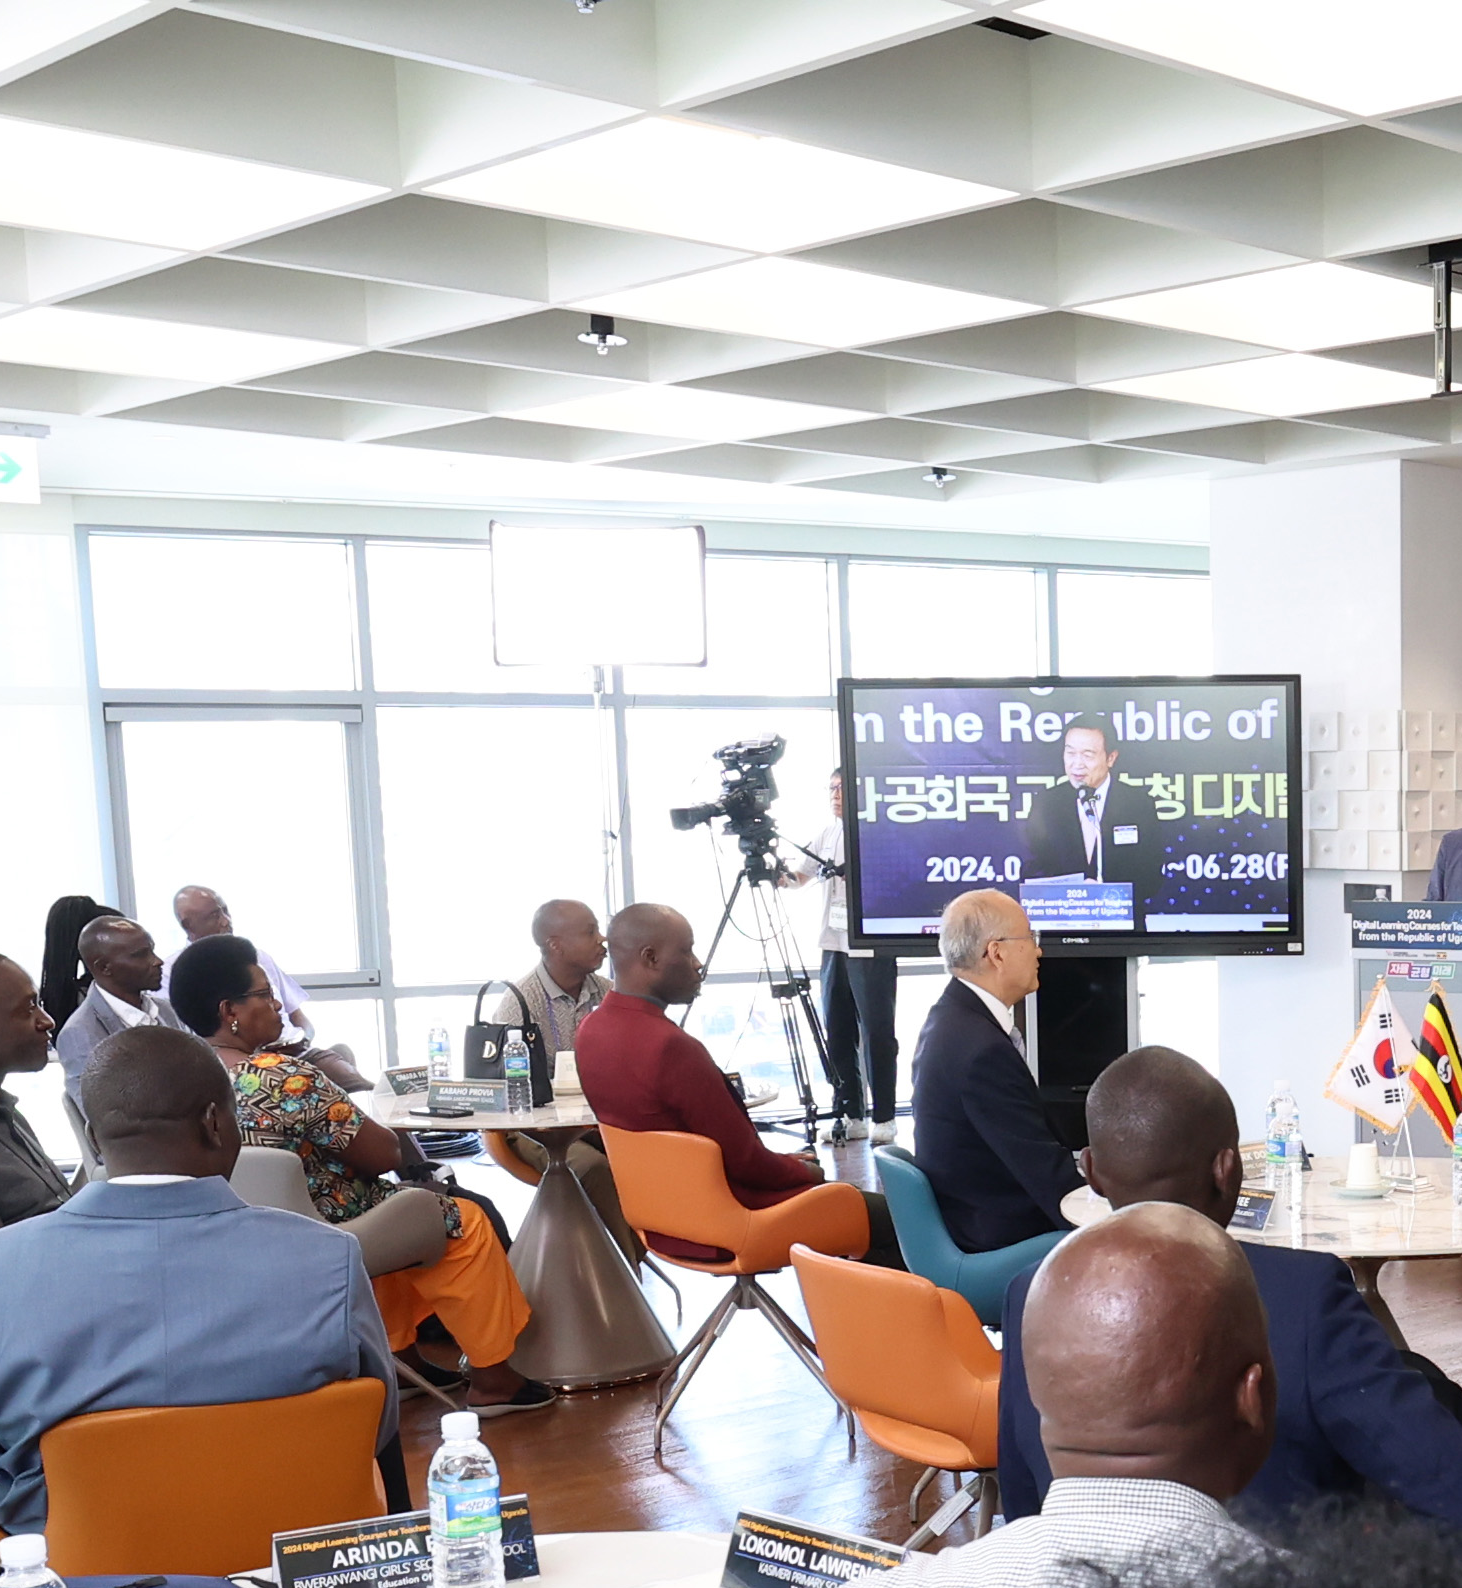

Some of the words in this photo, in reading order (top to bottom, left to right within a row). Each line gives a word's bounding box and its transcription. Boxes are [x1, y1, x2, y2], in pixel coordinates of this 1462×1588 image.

[900, 702, 983, 742] the
[1228, 698, 1278, 739] of
[1407, 909, 1432, 919] 2024
[1358, 931, 1379, 940] from
[1381, 932, 1396, 941] the
[1398, 932, 1434, 943] Republic
[1437, 933, 1446, 942] of
[332, 1538, 420, 1569] ARINDA
[739, 1532, 806, 1567] LOKOMOL
[810, 1552, 886, 1581] LAWREN
